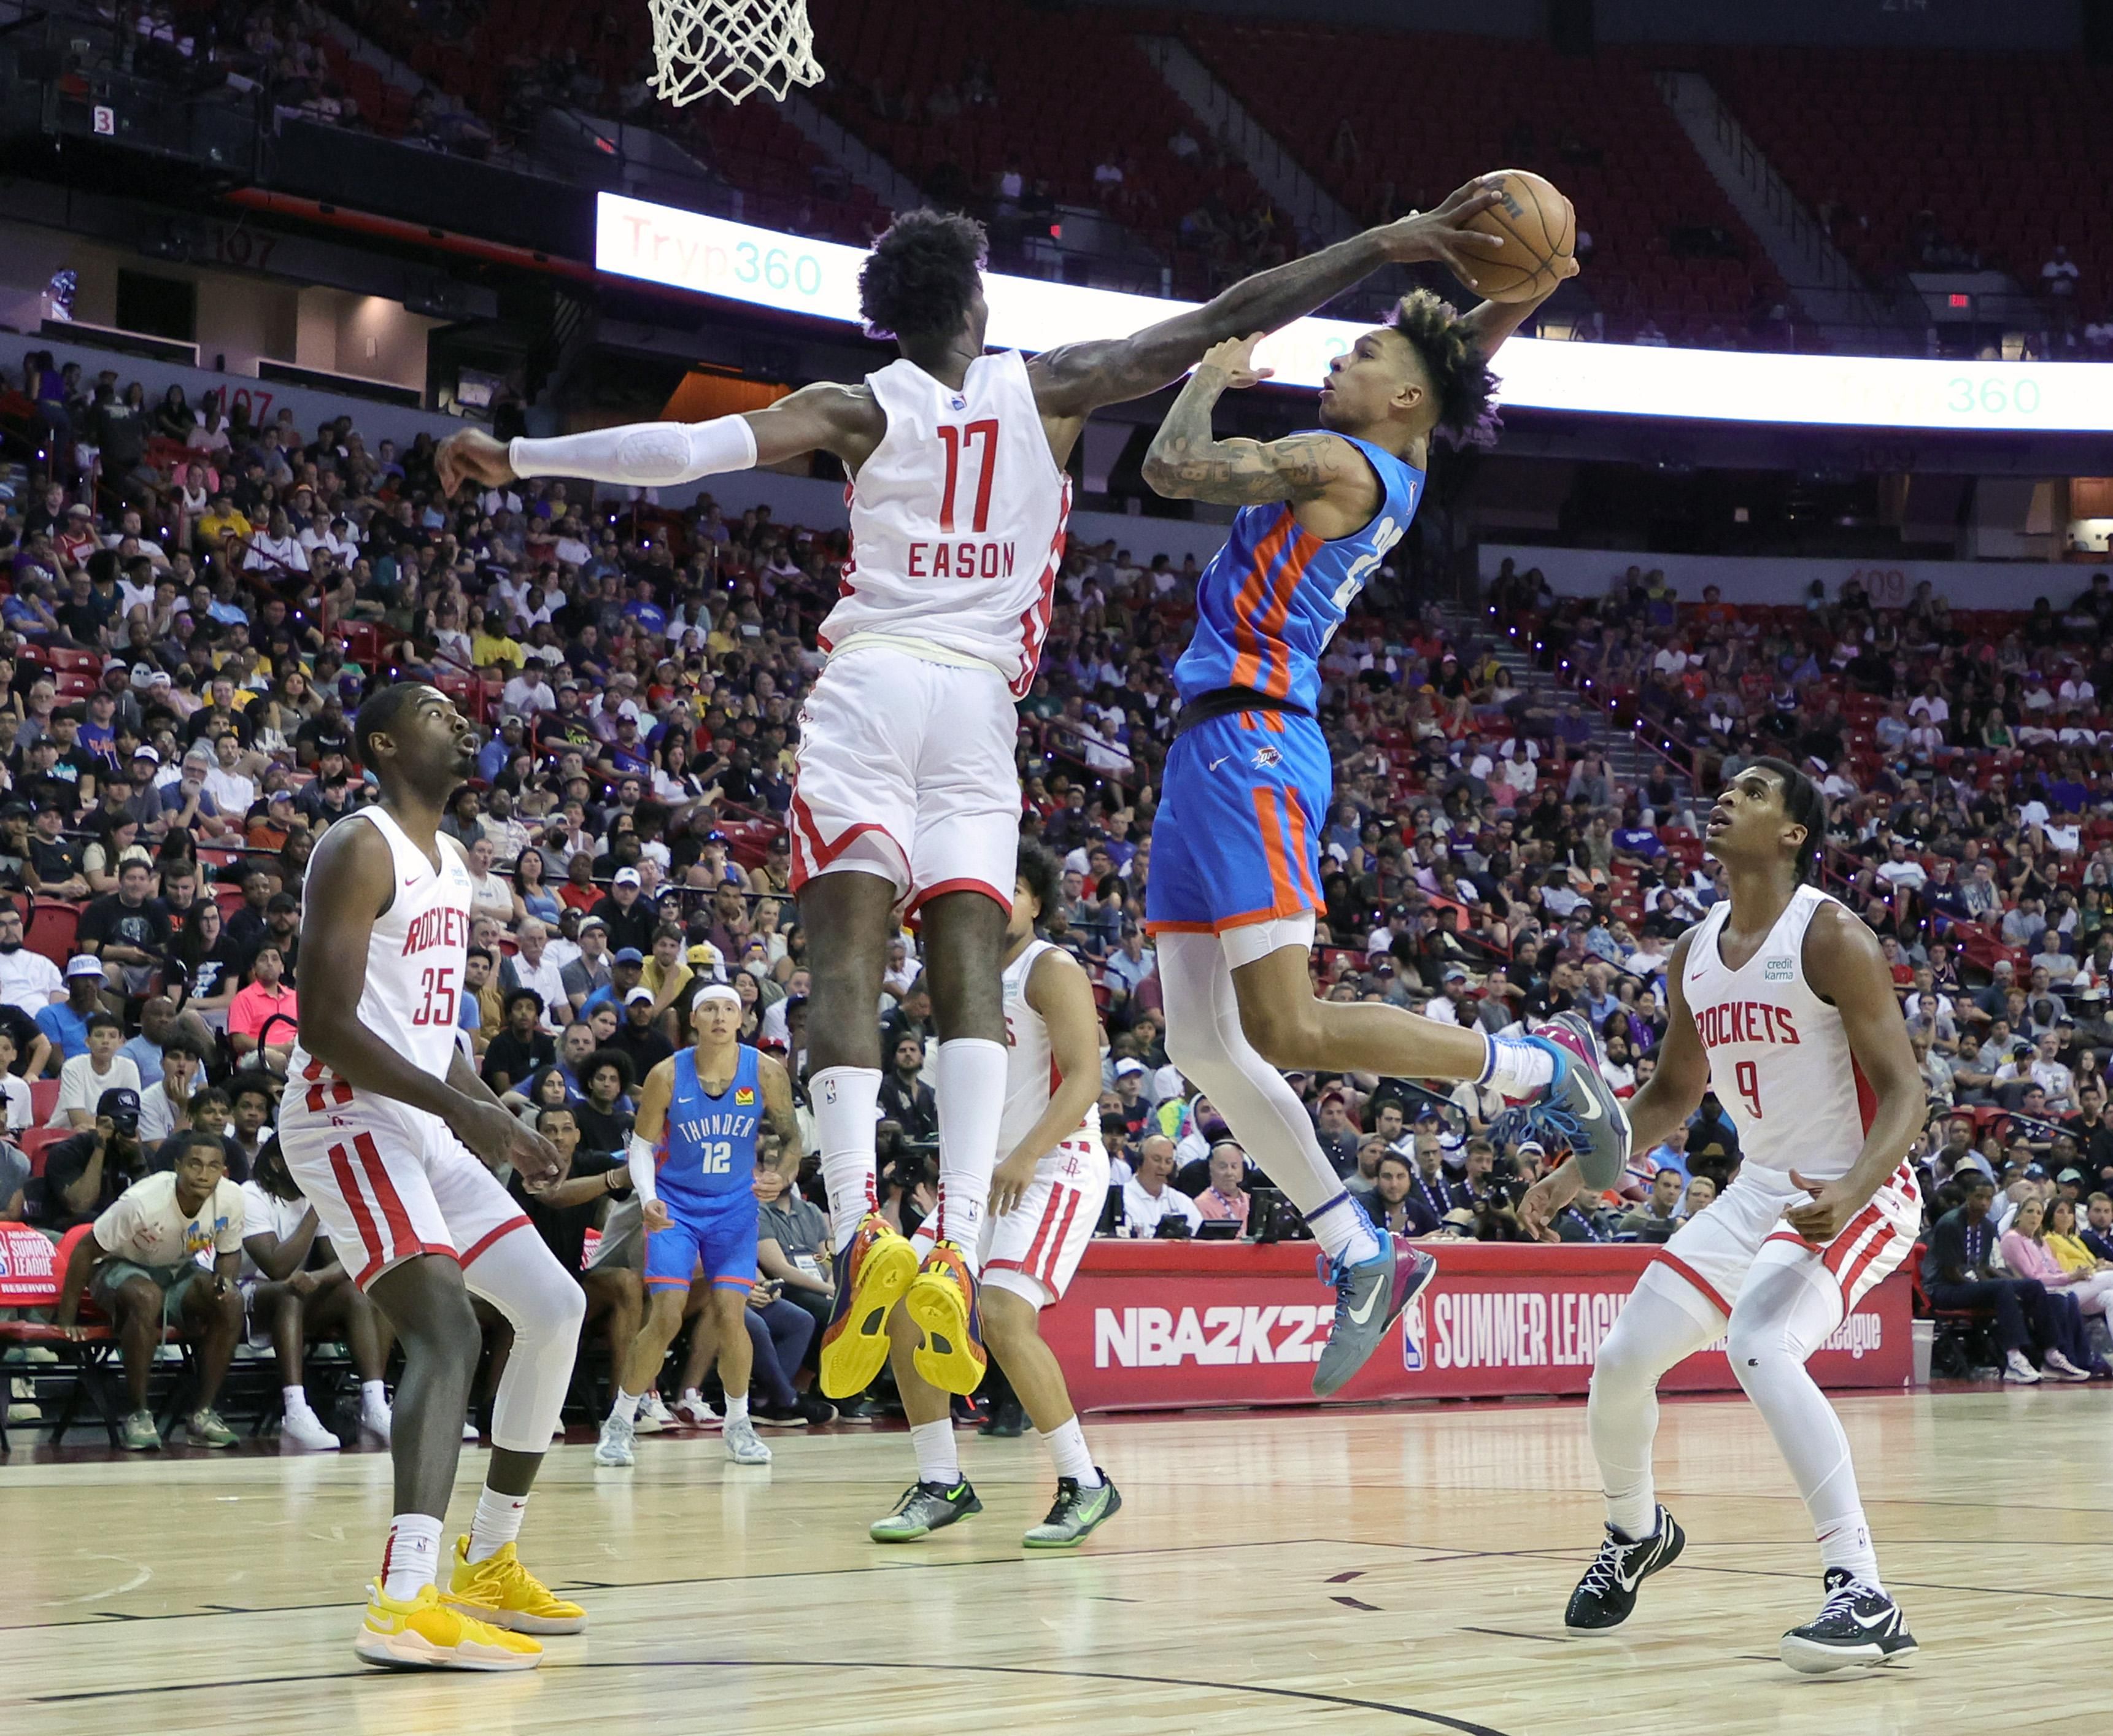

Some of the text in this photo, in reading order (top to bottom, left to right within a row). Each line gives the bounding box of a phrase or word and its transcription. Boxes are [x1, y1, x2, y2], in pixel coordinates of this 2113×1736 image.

[97, 110, 110, 131] 3
[937, 419, 999, 534] 17
[908, 541, 1015, 579] EASON
[1764, 970, 1793, 981] karma
[1767, 958, 1793, 970] credit
[412, 967, 455, 1026] 35
[1696, 1001, 1801, 1051] ROCKETS
[1735, 1060, 1763, 1120] 9
[677, 1113, 755, 1144] THUNDER
[700, 1141, 732, 1174] 12
[10, 1240, 57, 1258] SUMMER
[14, 1257, 54, 1276] LEAGUE
[1, 1283, 56, 1294] RESERVED
[1434, 1293, 1548, 1368] SUMMER
